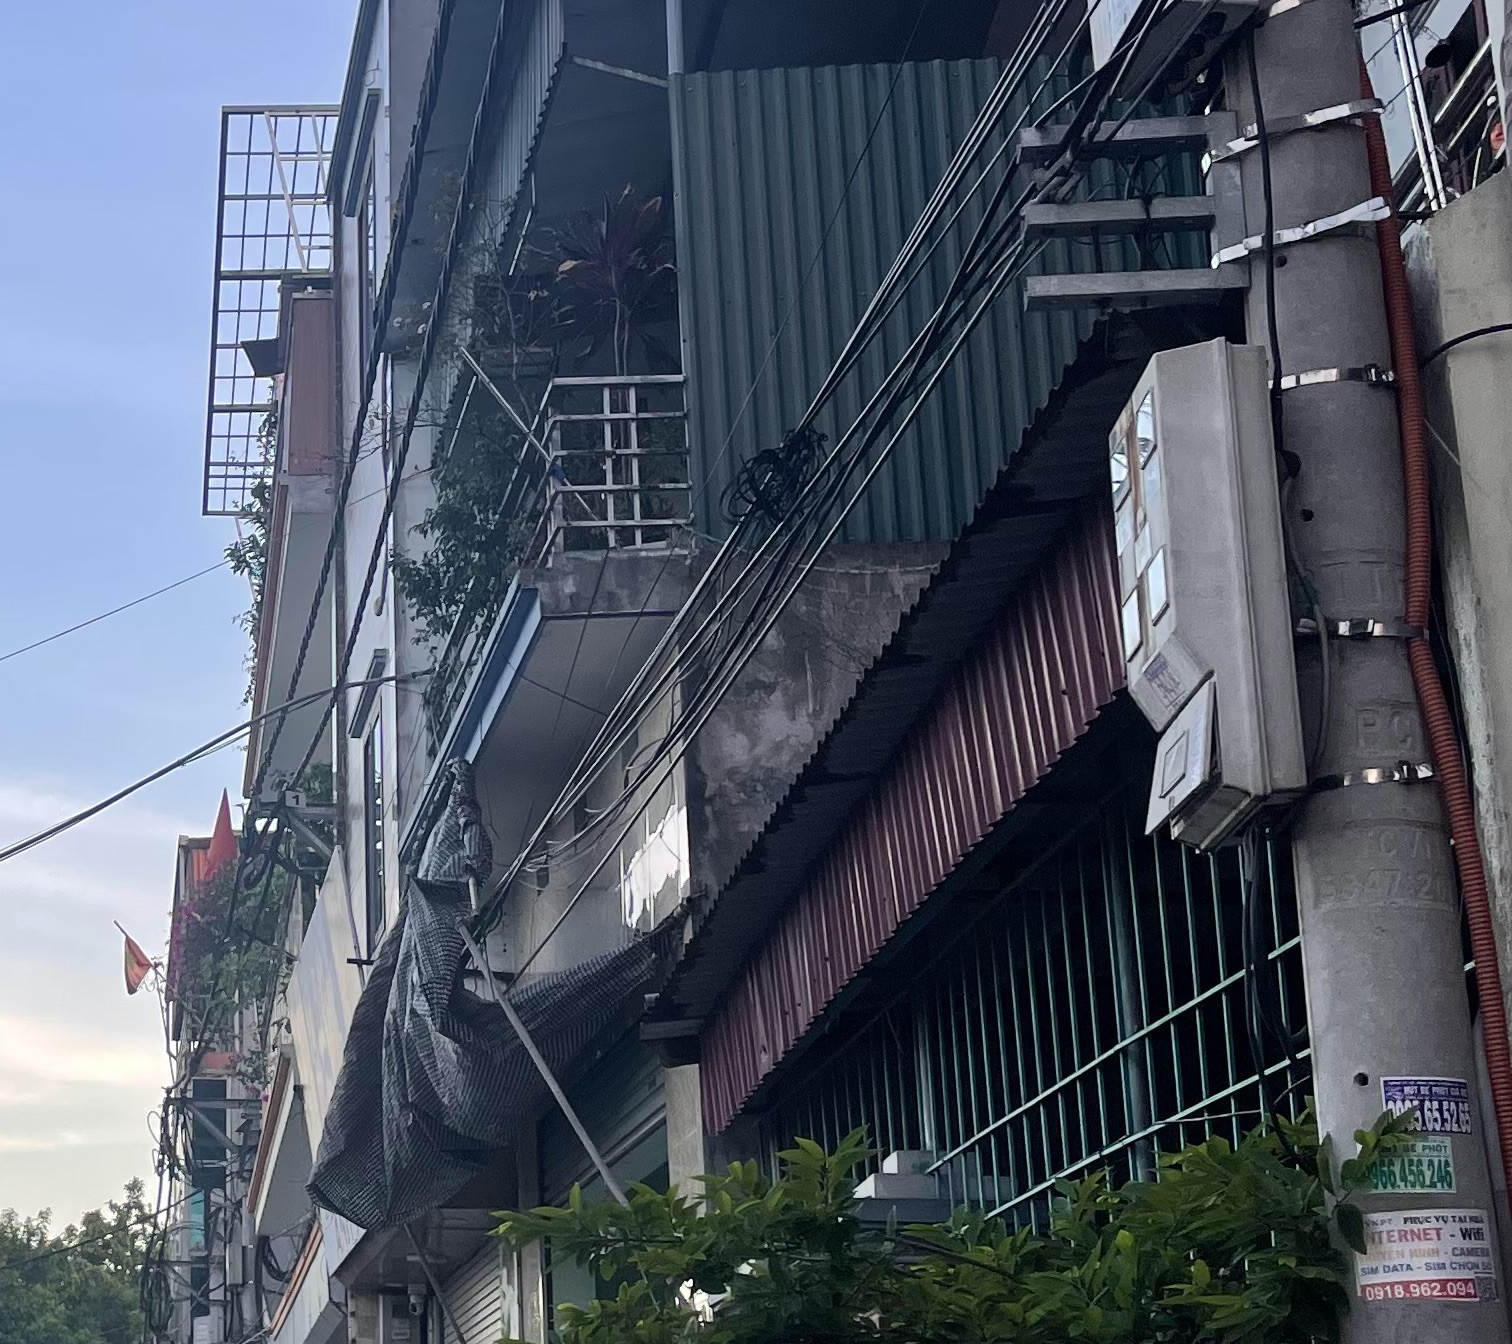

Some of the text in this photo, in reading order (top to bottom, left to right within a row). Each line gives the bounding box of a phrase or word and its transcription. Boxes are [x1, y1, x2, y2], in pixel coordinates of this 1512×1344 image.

[1370, 1157, 1453, 1190] 966.456.246
[1365, 1227, 1443, 1245] NTERNET
[1382, 1263, 1414, 1273] DATA
[1365, 1281, 1476, 1301] 0918.962.094
